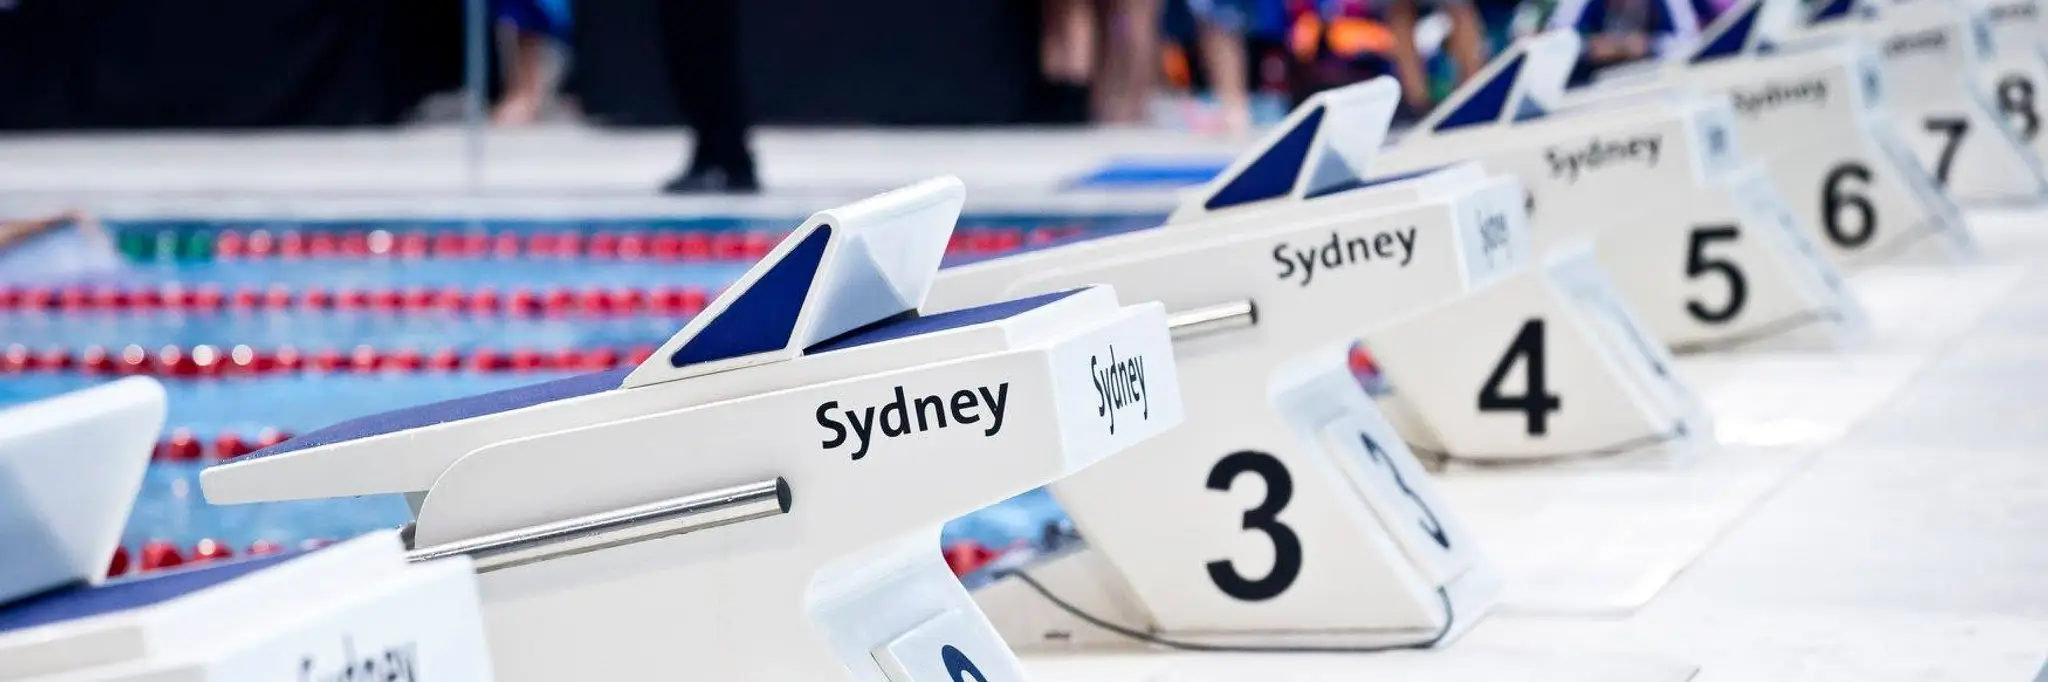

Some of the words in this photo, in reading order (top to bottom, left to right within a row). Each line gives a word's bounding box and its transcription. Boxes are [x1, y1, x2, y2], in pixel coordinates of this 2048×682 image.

[1997, 75, 2041, 142] 8
[1546, 135, 1662, 178] Sydney
[1924, 116, 1970, 190] 7
[1820, 162, 1877, 249] 6
[1273, 227, 1416, 286] Sydney
[1685, 224, 1748, 325] 5
[1090, 344, 1148, 436] Sydney
[1477, 317, 1561, 437] 4
[815, 382, 1009, 461] Sydney
[1205, 449, 1303, 603] 3
